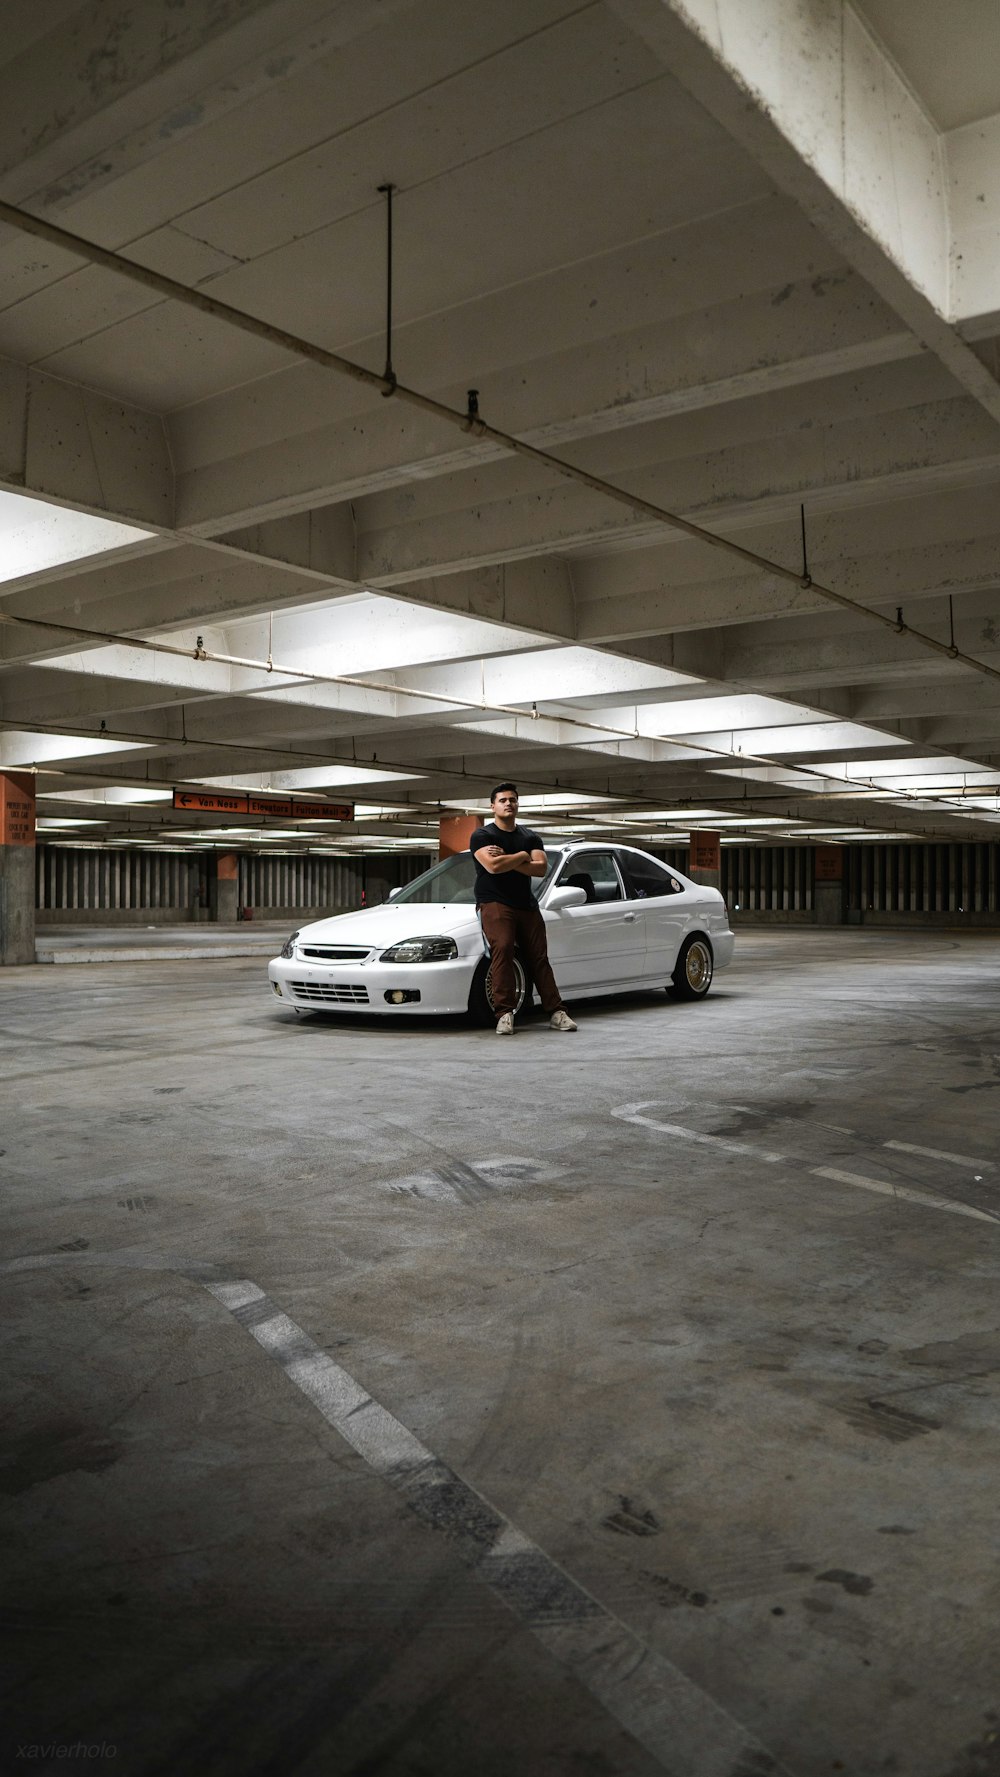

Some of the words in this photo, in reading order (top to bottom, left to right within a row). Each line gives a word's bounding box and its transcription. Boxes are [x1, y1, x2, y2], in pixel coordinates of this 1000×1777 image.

[199, 798, 214, 807] Van
[217, 800, 238, 809] Ness
[251, 802, 288, 813] Elevators
[296, 806, 320, 815] Fulton
